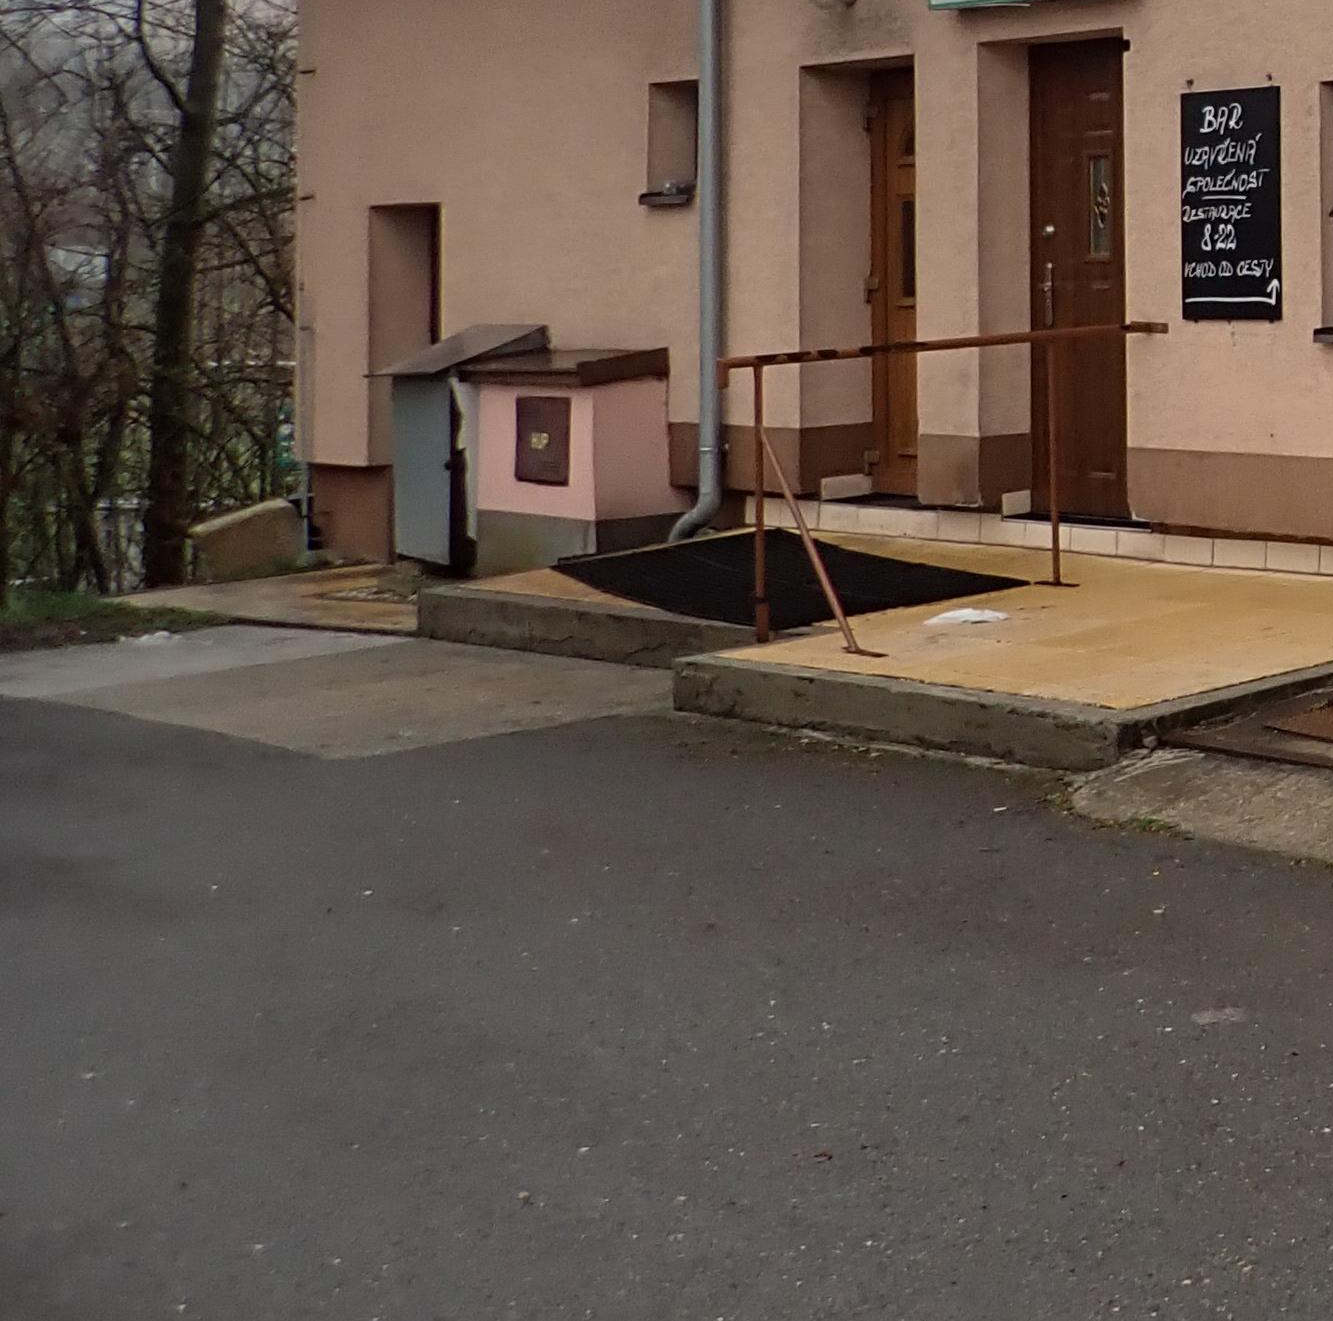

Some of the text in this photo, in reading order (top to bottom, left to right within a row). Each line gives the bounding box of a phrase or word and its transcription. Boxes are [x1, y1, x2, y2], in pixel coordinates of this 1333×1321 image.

[1200, 102, 1243, 134] BAR
[1182, 203, 1252, 223] RESTAURACE
[1218, 261, 1234, 277] OD
[1236, 258, 1274, 277] CESTY
